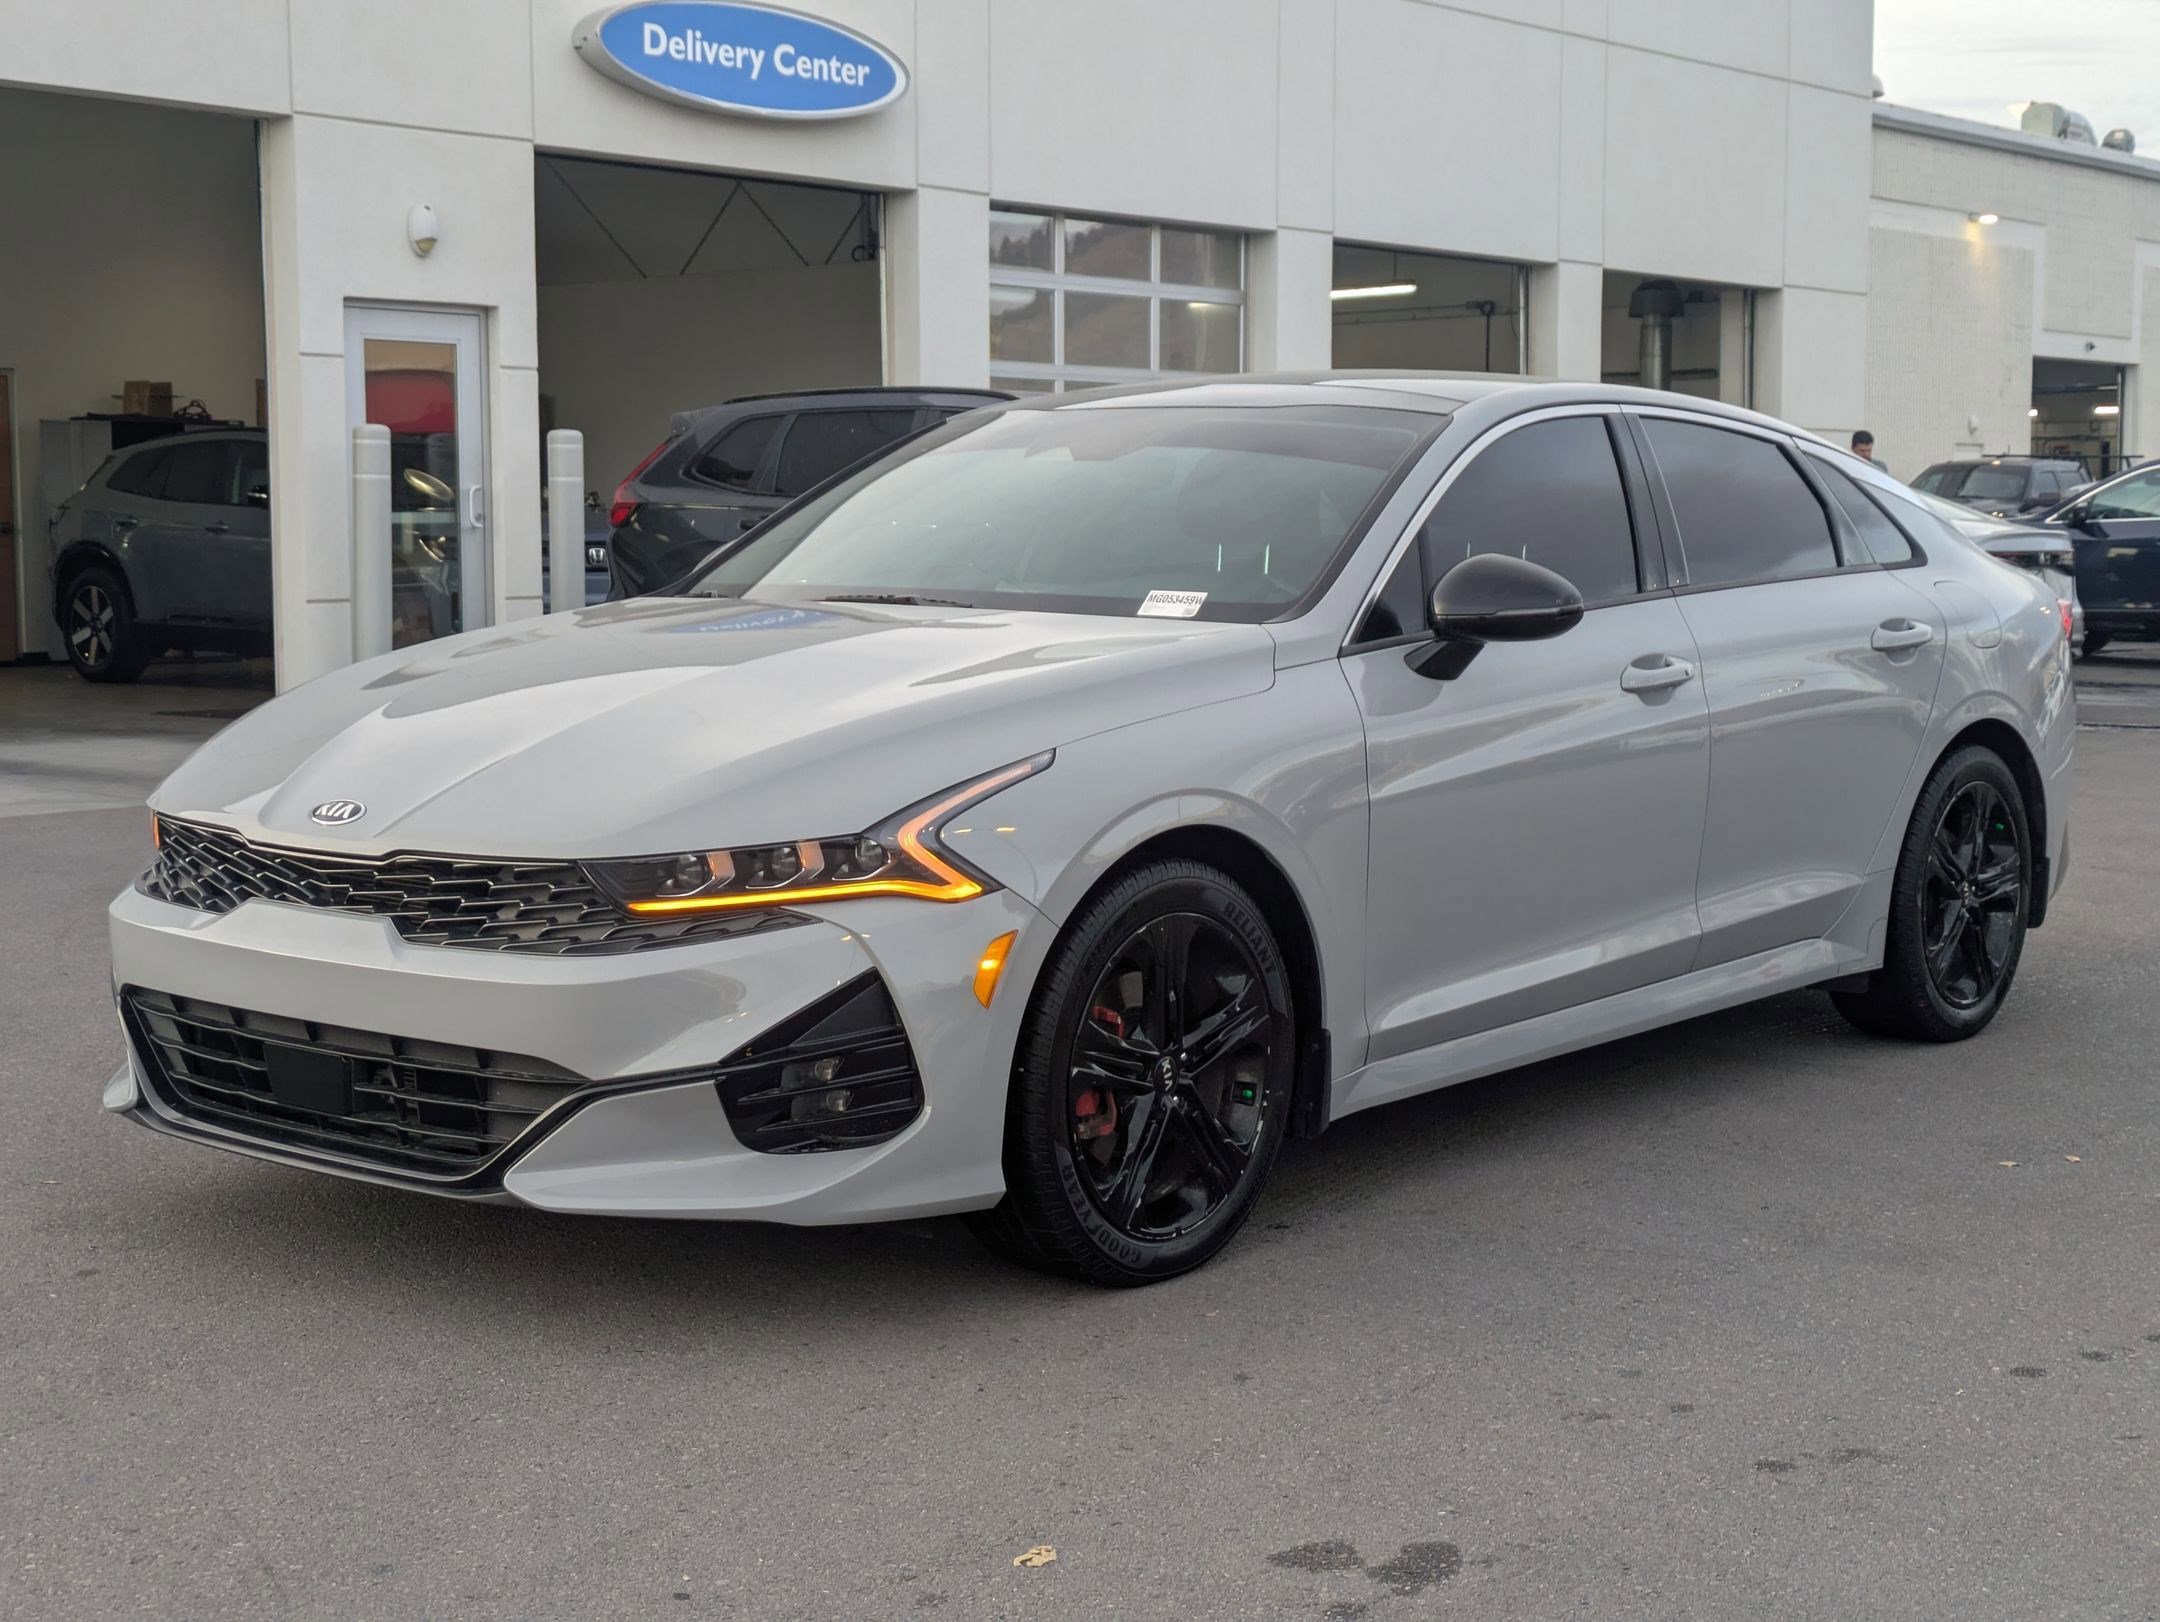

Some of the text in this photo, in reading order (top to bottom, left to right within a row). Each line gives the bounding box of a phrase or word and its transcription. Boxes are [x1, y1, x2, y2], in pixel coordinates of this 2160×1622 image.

[642, 22, 871, 87] Delivery Center
[314, 801, 356, 819] KIA
[1223, 901, 1278, 974] RELIANT
[1061, 1164, 1142, 1263] GOODYEAR
